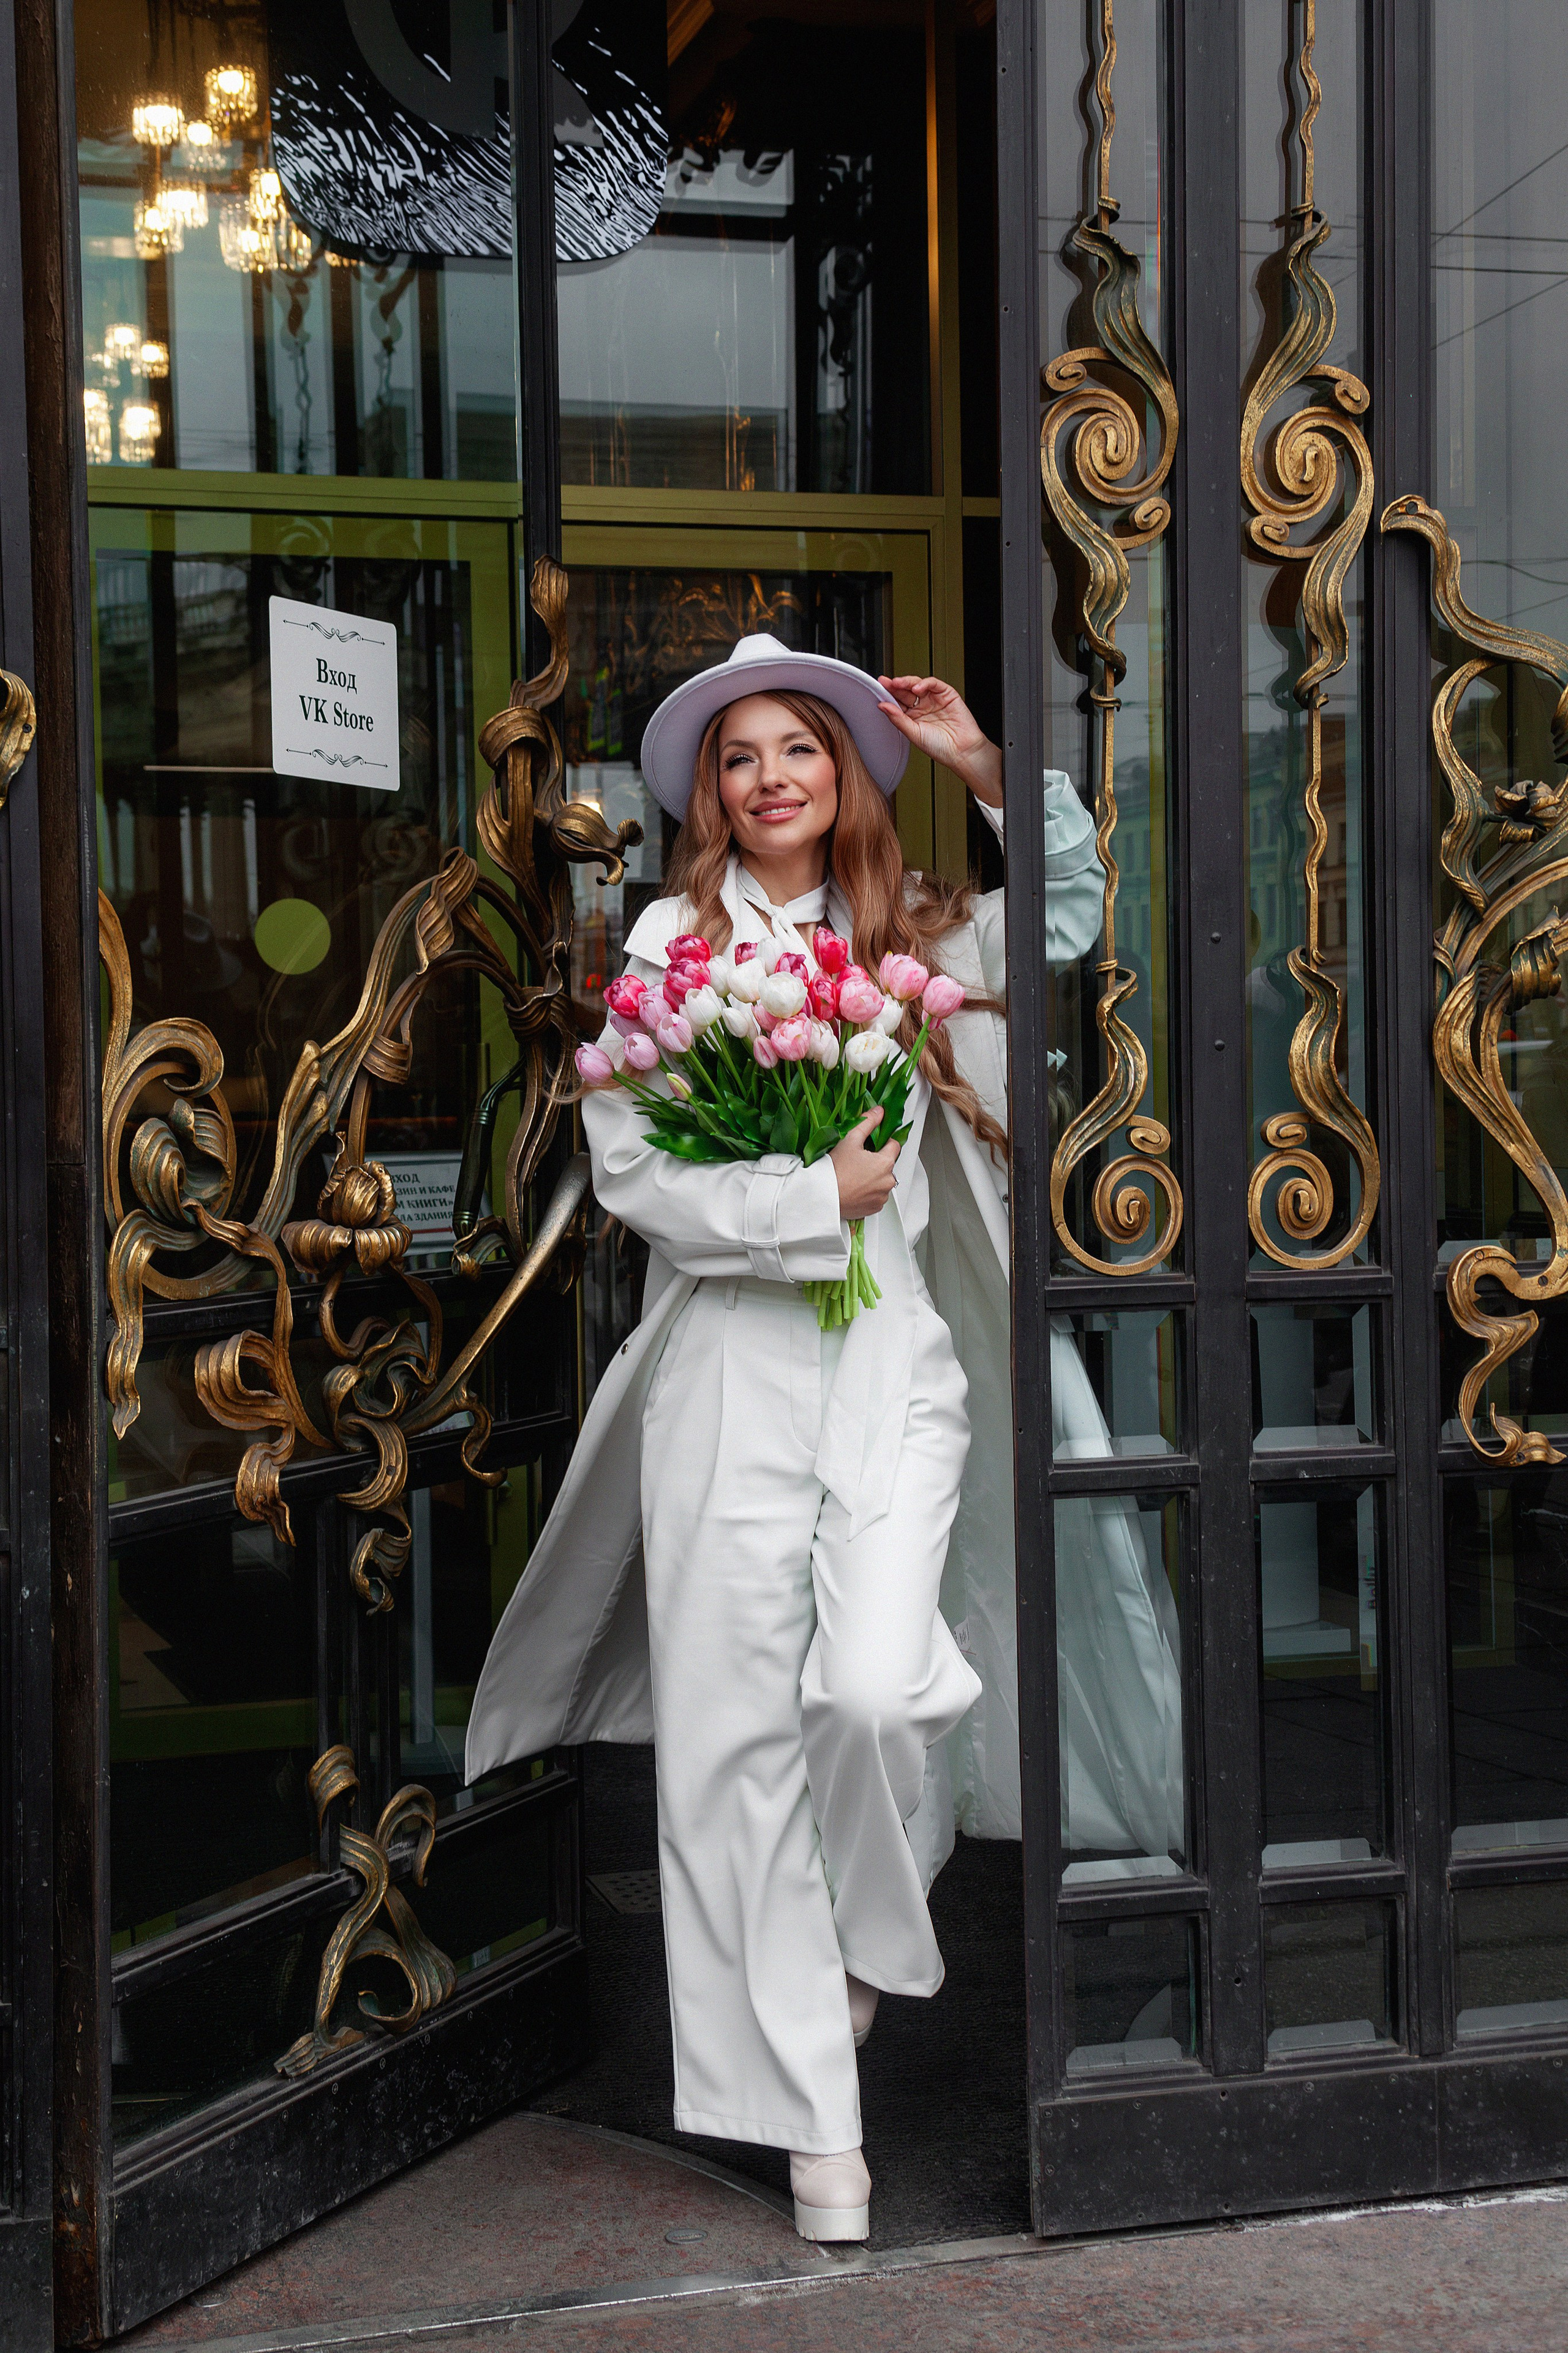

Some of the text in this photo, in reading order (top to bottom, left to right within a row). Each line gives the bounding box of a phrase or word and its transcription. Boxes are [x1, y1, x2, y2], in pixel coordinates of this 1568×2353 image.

[316, 658, 357, 695] Вход
[299, 694, 374, 733] VK Store
